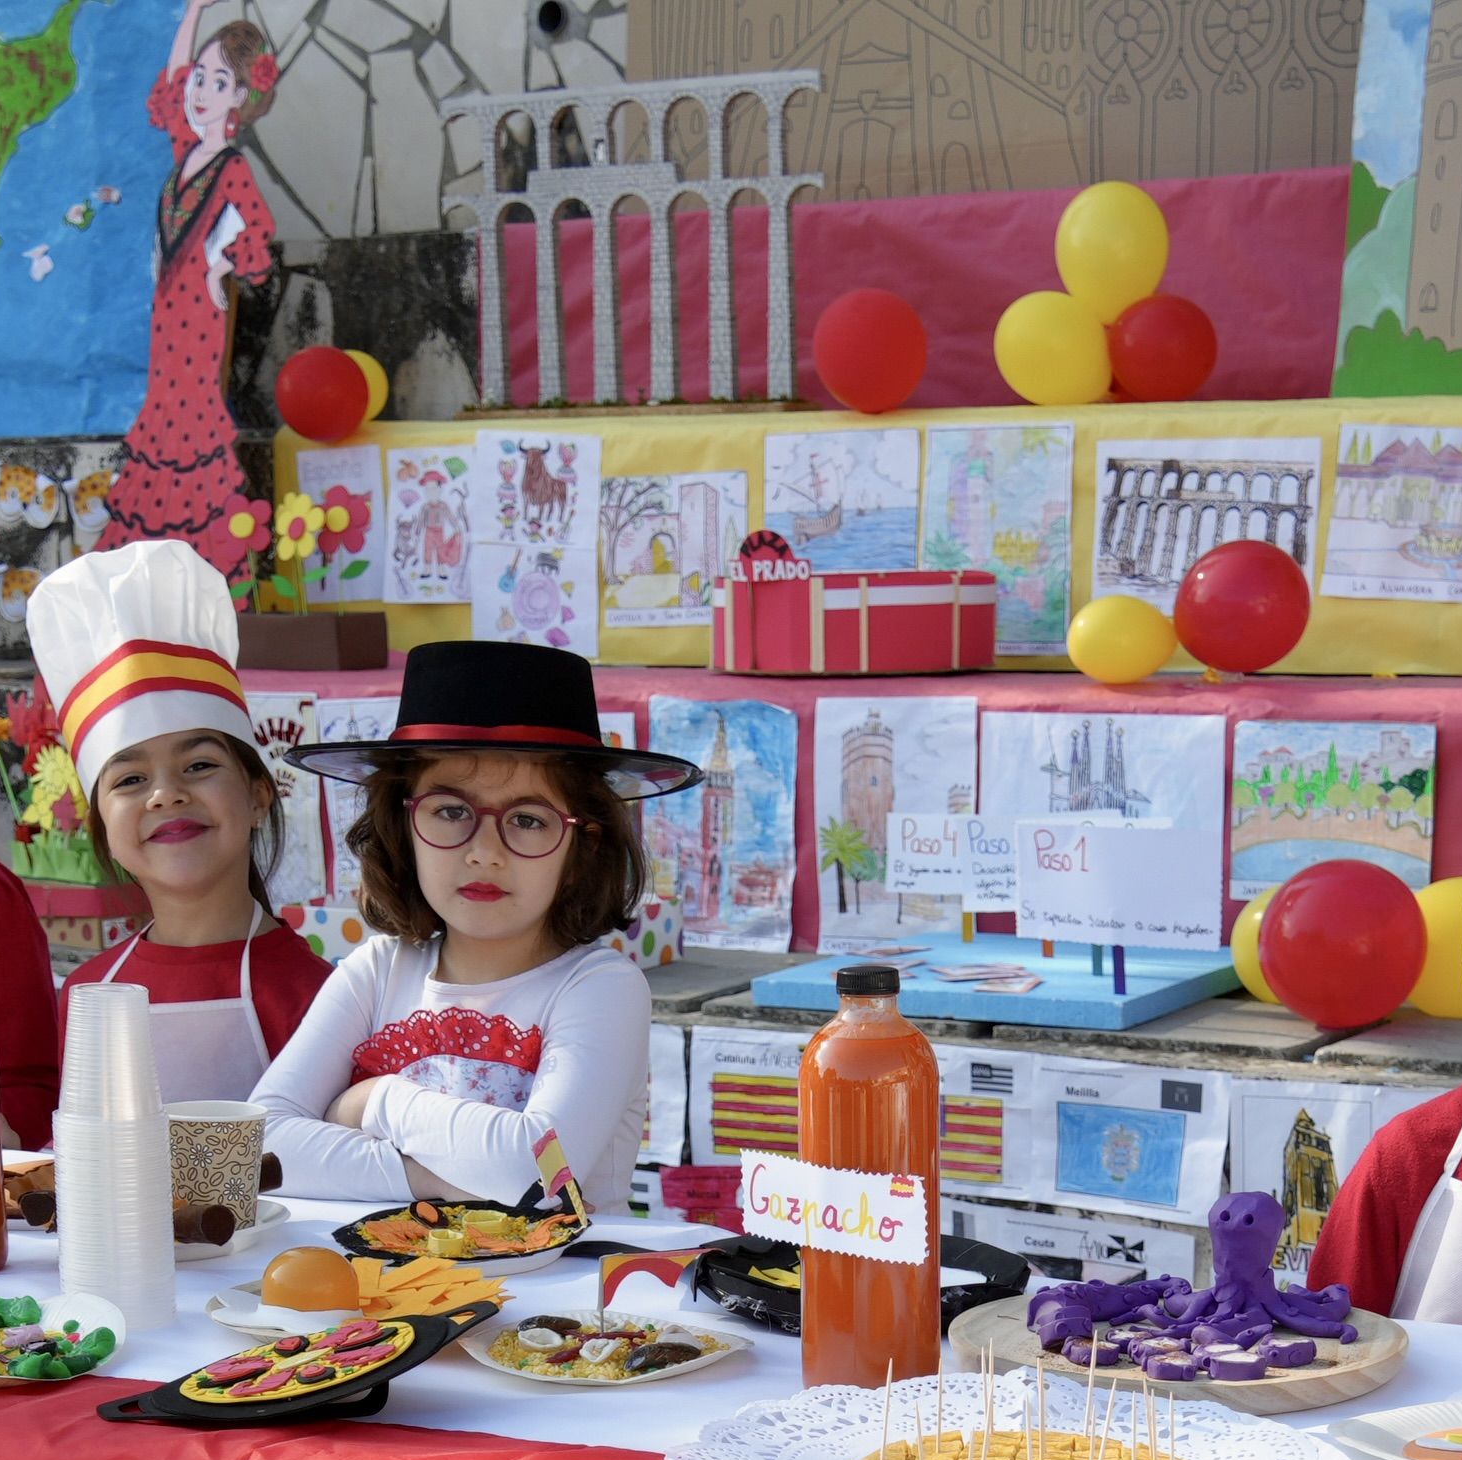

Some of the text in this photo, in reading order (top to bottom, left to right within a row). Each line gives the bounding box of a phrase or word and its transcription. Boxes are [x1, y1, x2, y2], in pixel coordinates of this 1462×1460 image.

[739, 532, 789, 558] PLAZA
[730, 560, 811, 582] EL PRADO
[1066, 1086, 1099, 1098] Melilla
[750, 1163, 903, 1246] Gazpacho
[1024, 1235, 1056, 1249] Ceuta
